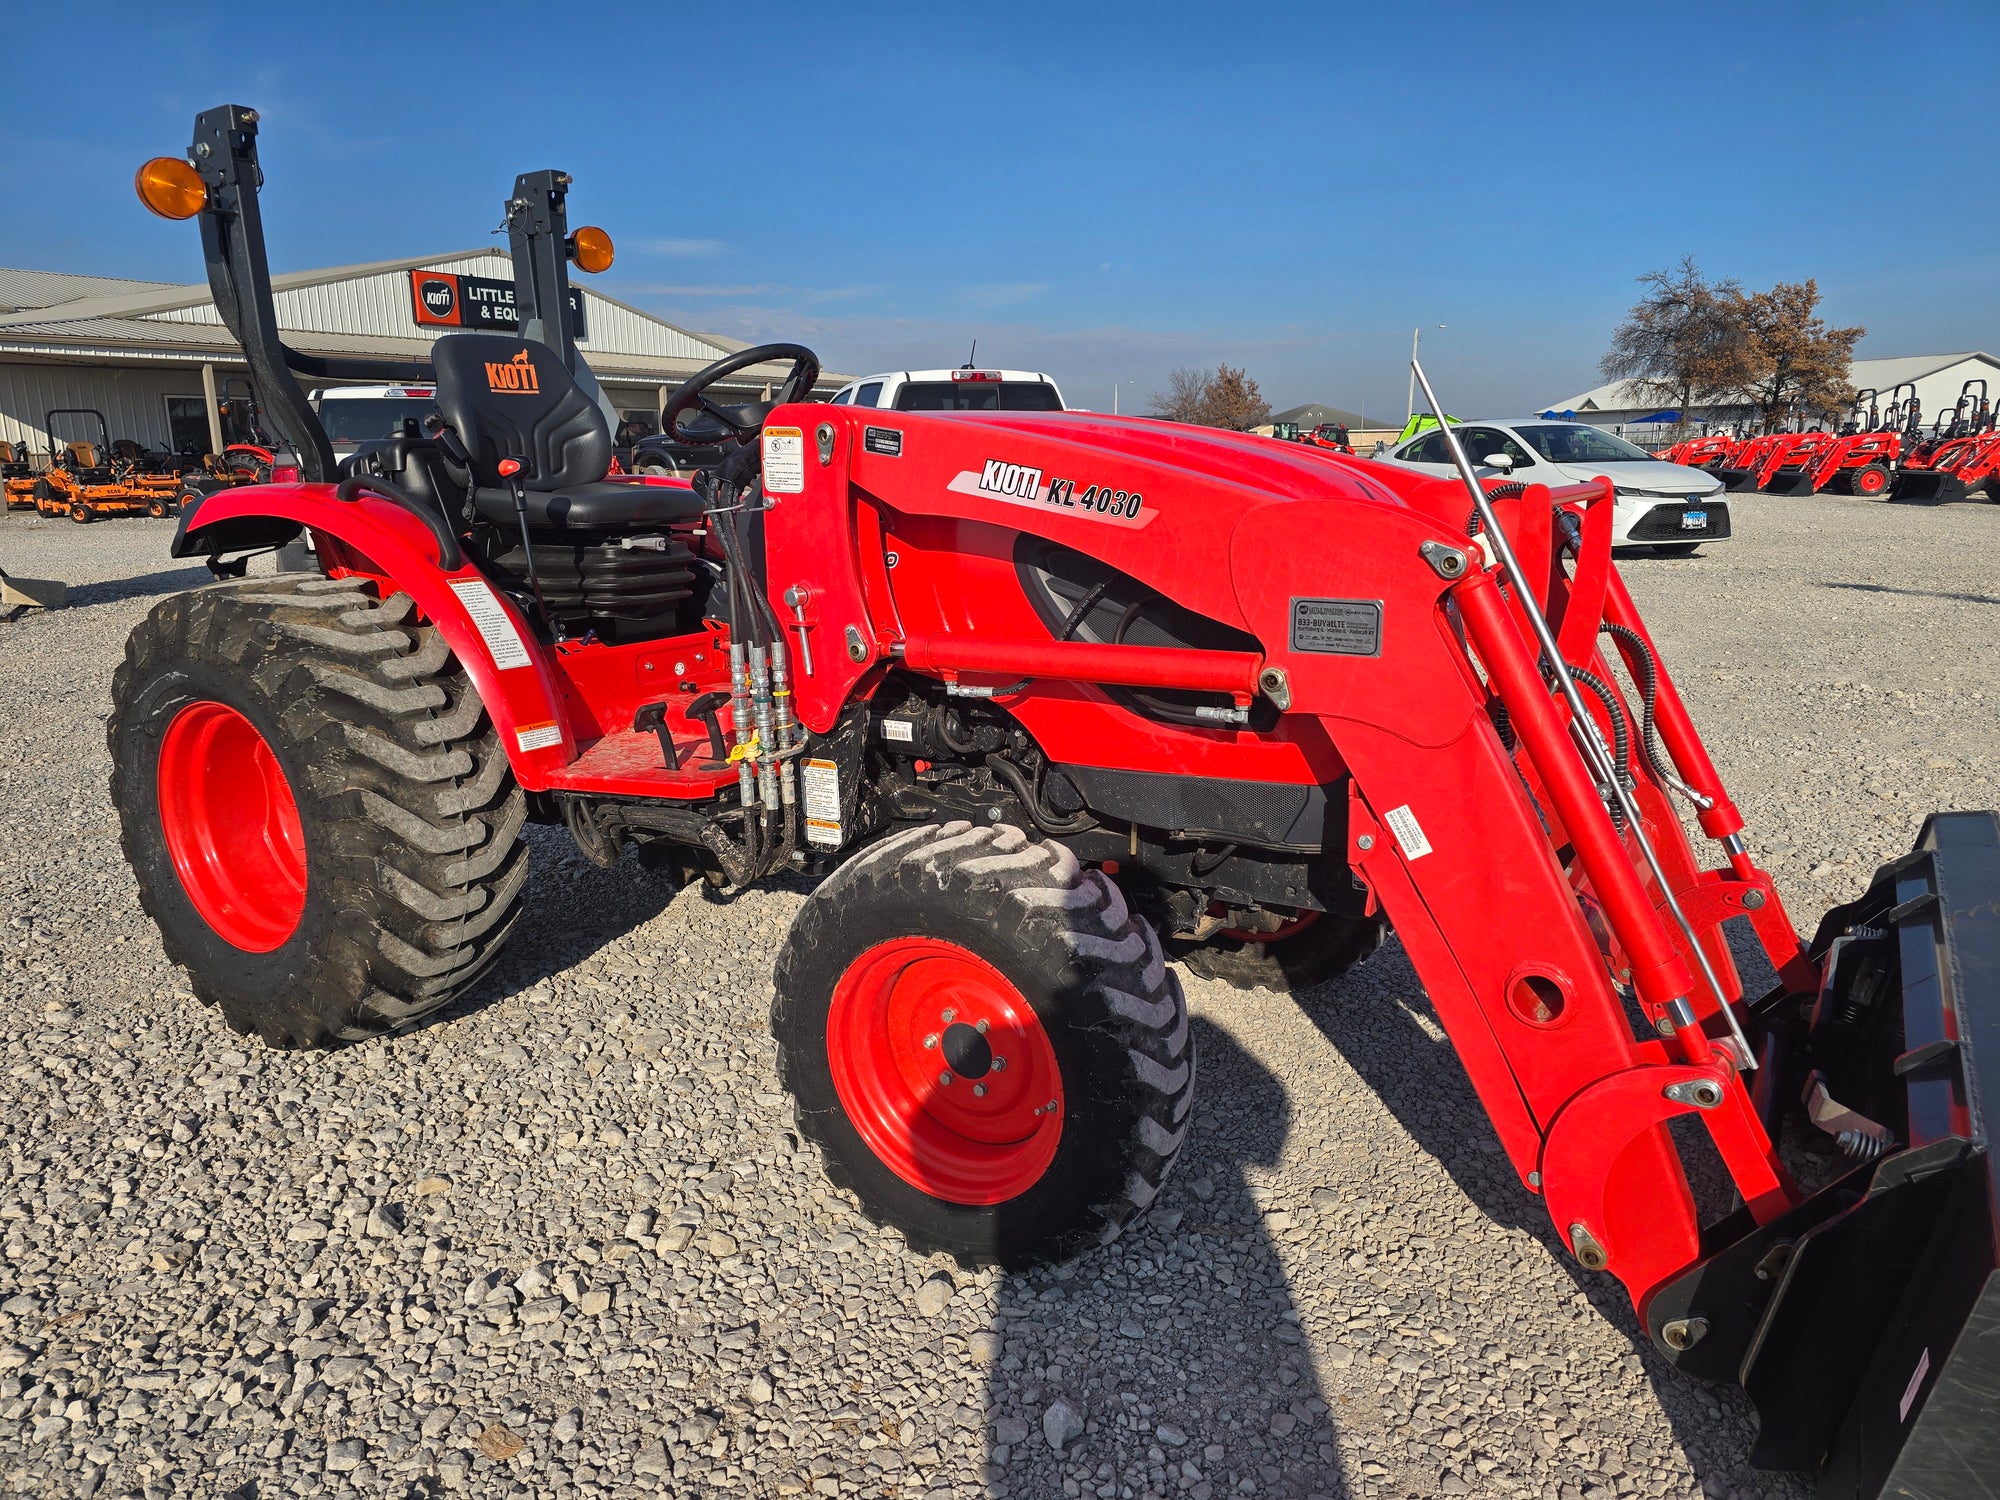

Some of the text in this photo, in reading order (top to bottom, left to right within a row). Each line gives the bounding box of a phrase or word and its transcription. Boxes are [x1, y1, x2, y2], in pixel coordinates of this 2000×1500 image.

[426, 292, 450, 306] KIOTI
[468, 286, 515, 304] LITTLE
[480, 305, 491, 319] &
[484, 362, 540, 390] KIOTI
[978, 458, 1143, 520] KIOTI KL 4030
